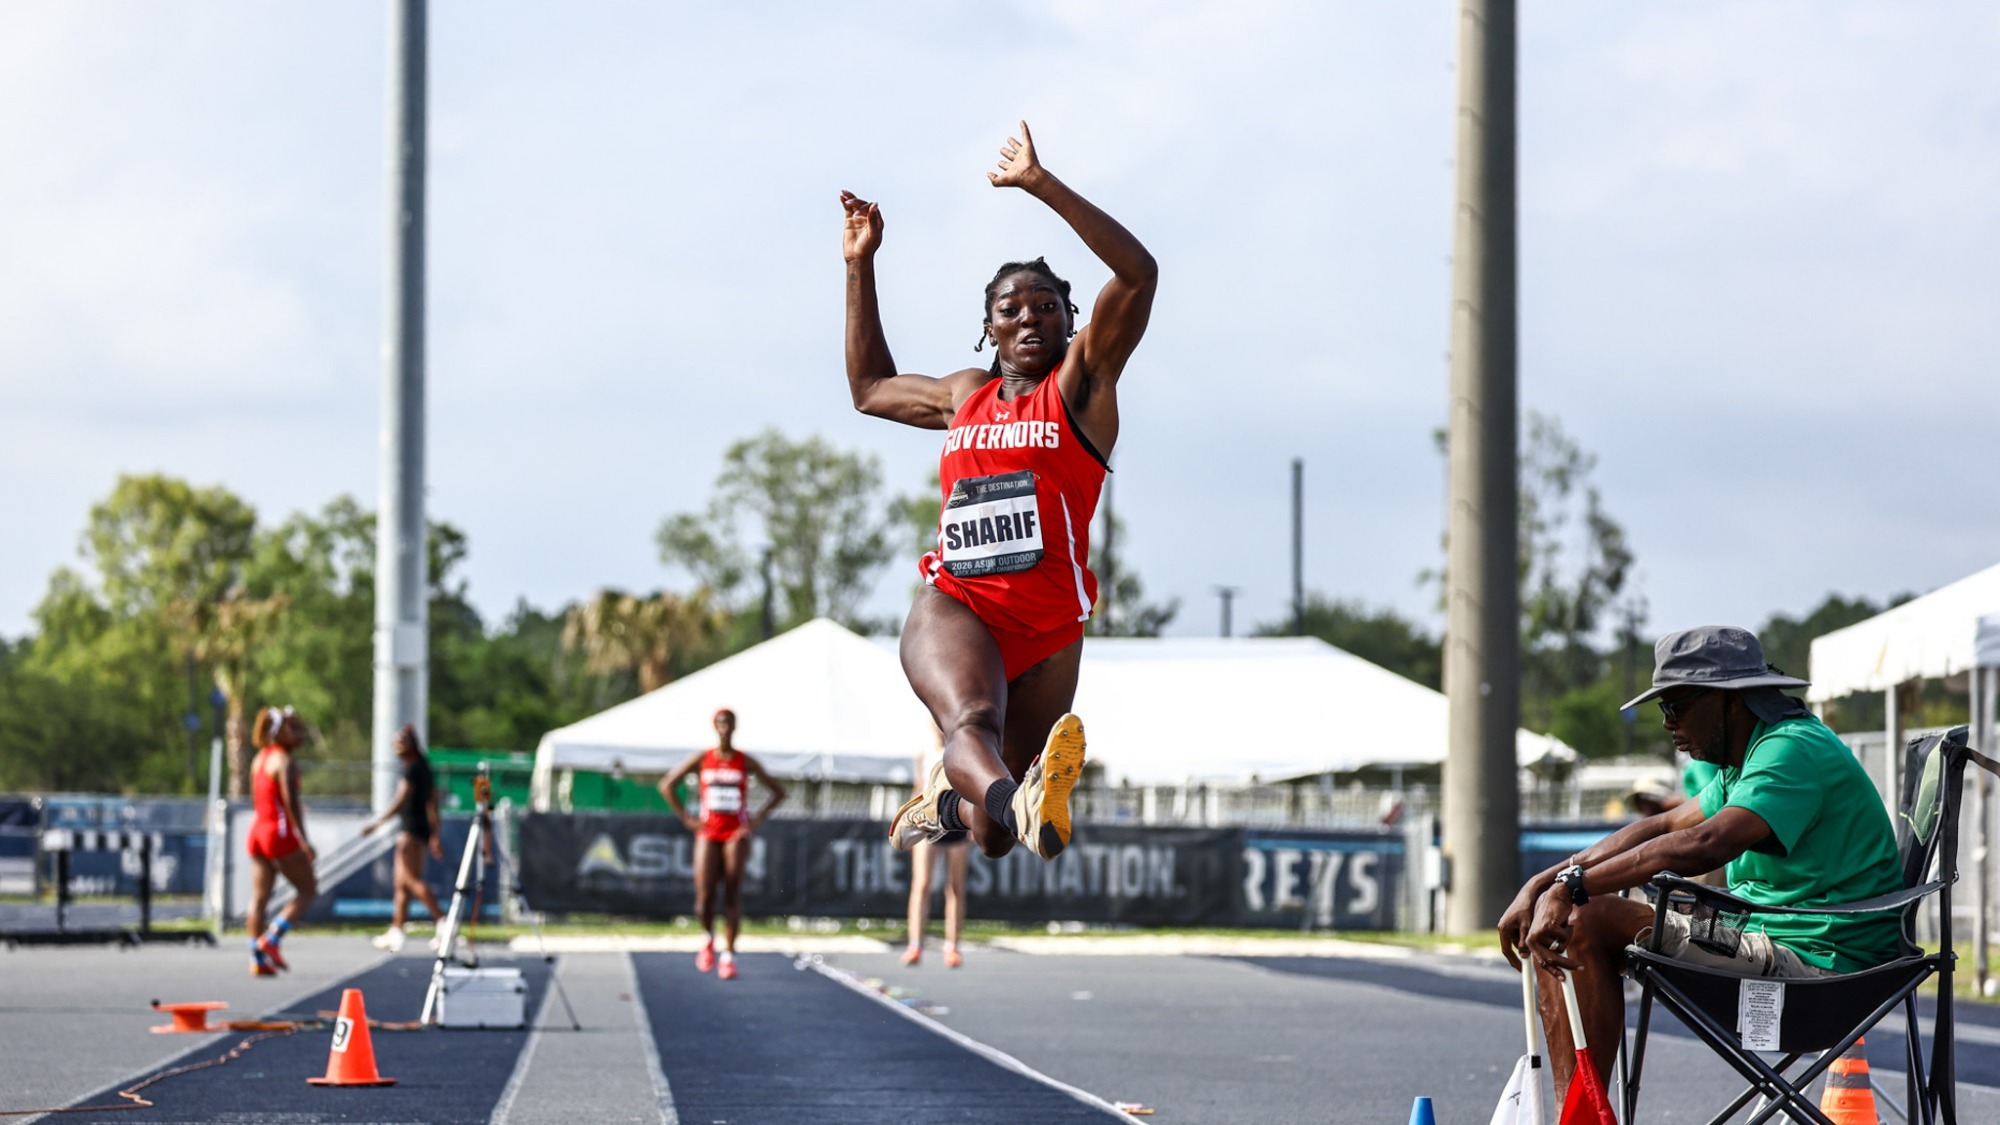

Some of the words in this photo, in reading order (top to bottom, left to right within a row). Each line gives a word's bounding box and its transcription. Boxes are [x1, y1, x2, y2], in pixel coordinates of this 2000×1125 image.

[943, 420, 1060, 456] GOVERNORS
[975, 484, 988, 493] THE
[945, 510, 1037, 551] SHARIF
[951, 561, 972, 571] 2026
[974, 558, 996, 569] ASUN
[998, 552, 1037, 566] OUTDOOR
[831, 838, 906, 893] THE
[333, 1020, 349, 1047] 9
